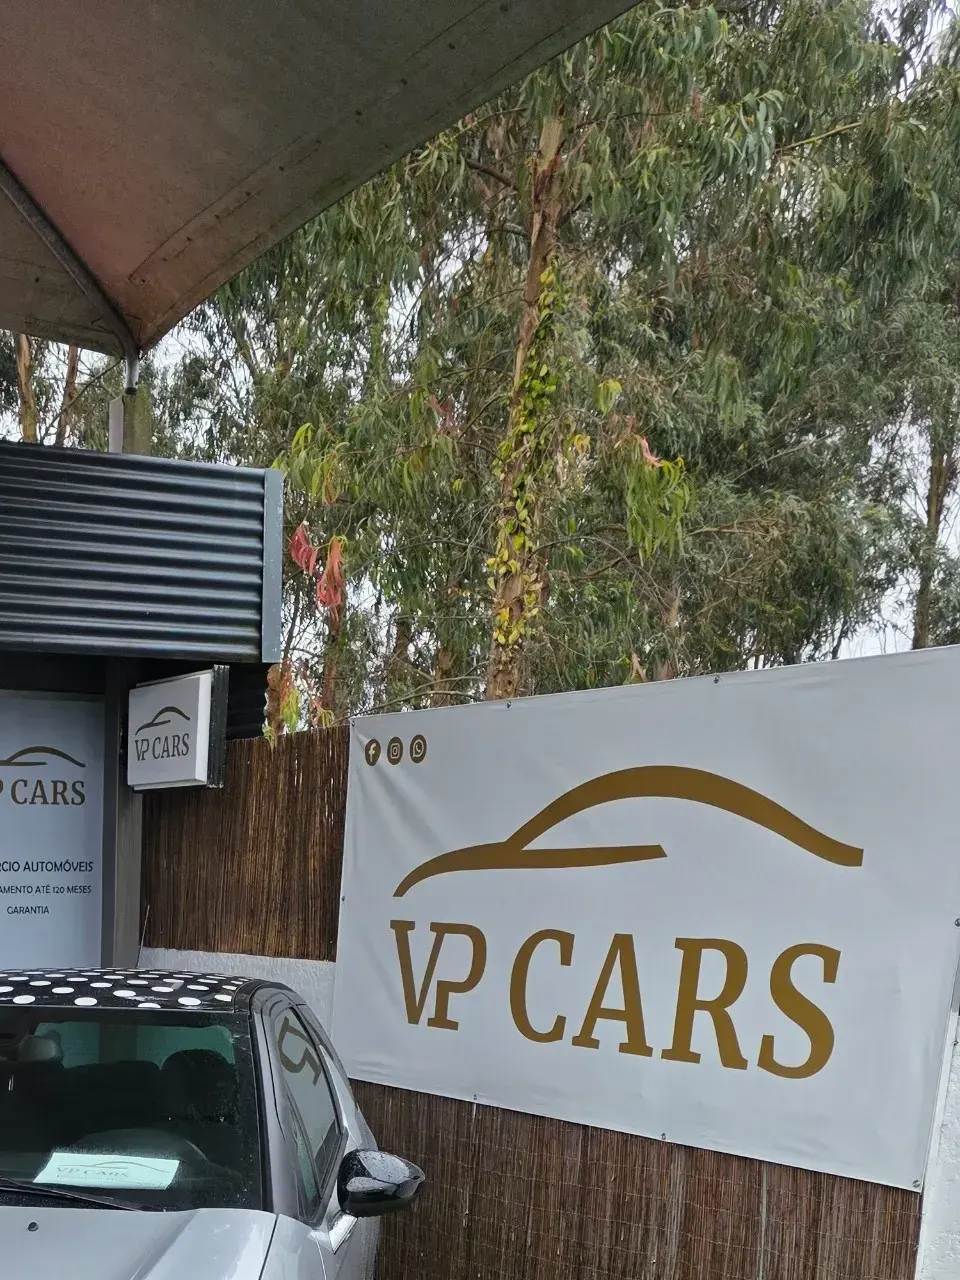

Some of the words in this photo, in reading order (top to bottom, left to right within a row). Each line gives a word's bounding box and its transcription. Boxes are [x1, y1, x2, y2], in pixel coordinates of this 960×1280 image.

[134, 739, 150, 761] VP
[152, 733, 190, 759] CARS
[10, 778, 86, 806] CARS
[23, 859, 94, 872] AUTOMÓVEIS
[34, 884, 51, 894] ATÉ
[52, 886, 65, 894] 120
[67, 885, 92, 894] MESES
[6, 905, 50, 915] GARANTIA
[390, 920, 487, 1031] VP
[509, 928, 842, 1080] CARS
